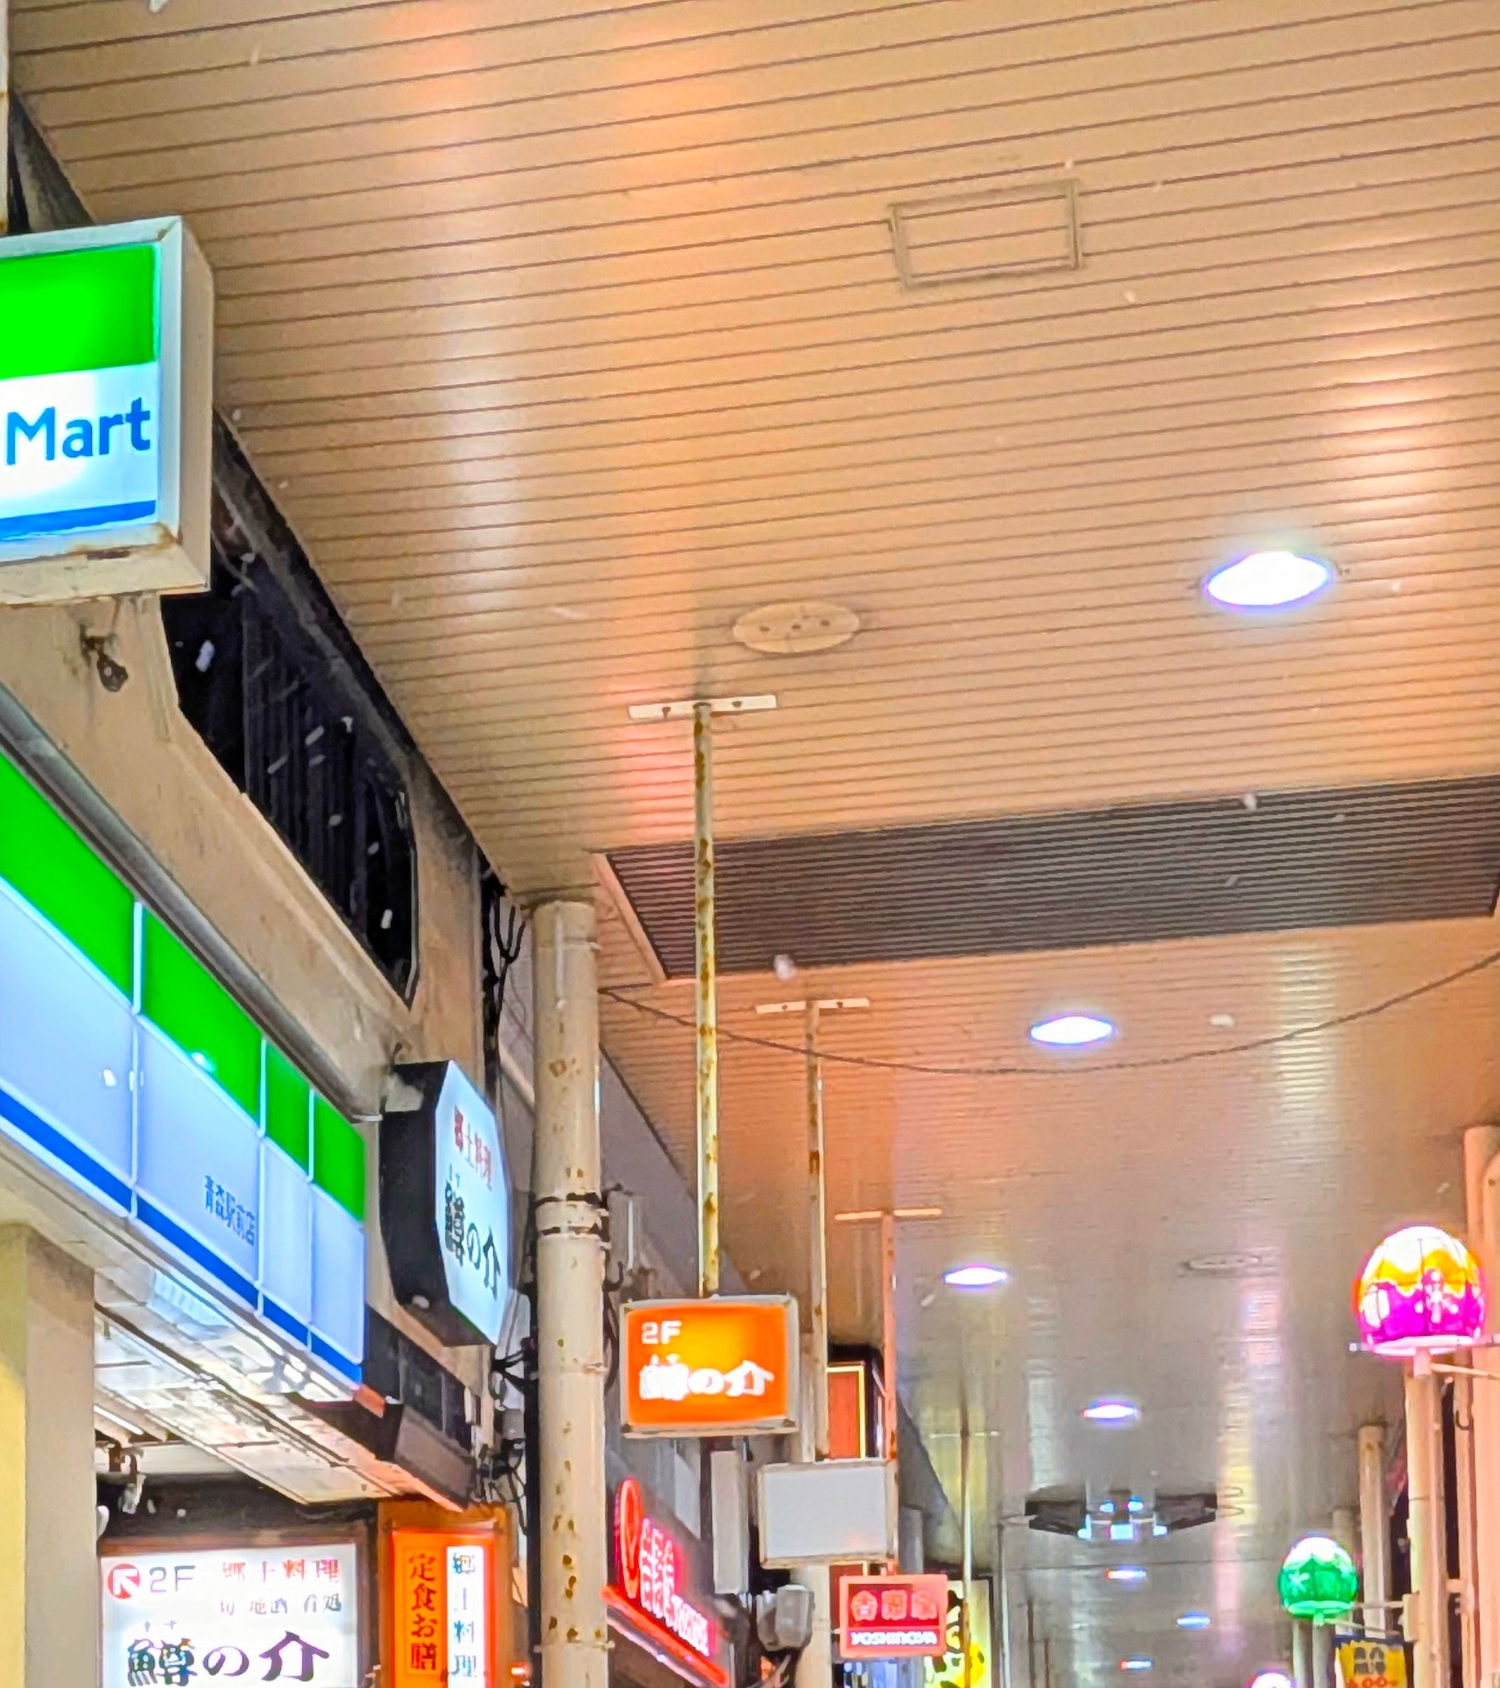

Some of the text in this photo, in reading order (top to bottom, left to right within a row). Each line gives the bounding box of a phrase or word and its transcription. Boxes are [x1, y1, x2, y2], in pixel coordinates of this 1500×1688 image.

[6, 398, 150, 465] Mart
[641, 1320, 682, 1345] 2F
[150, 1565, 196, 1593] 2F
[409, 1553, 438, 1670] 定食お膳
[127, 1631, 330, 1687] 鱒の介
